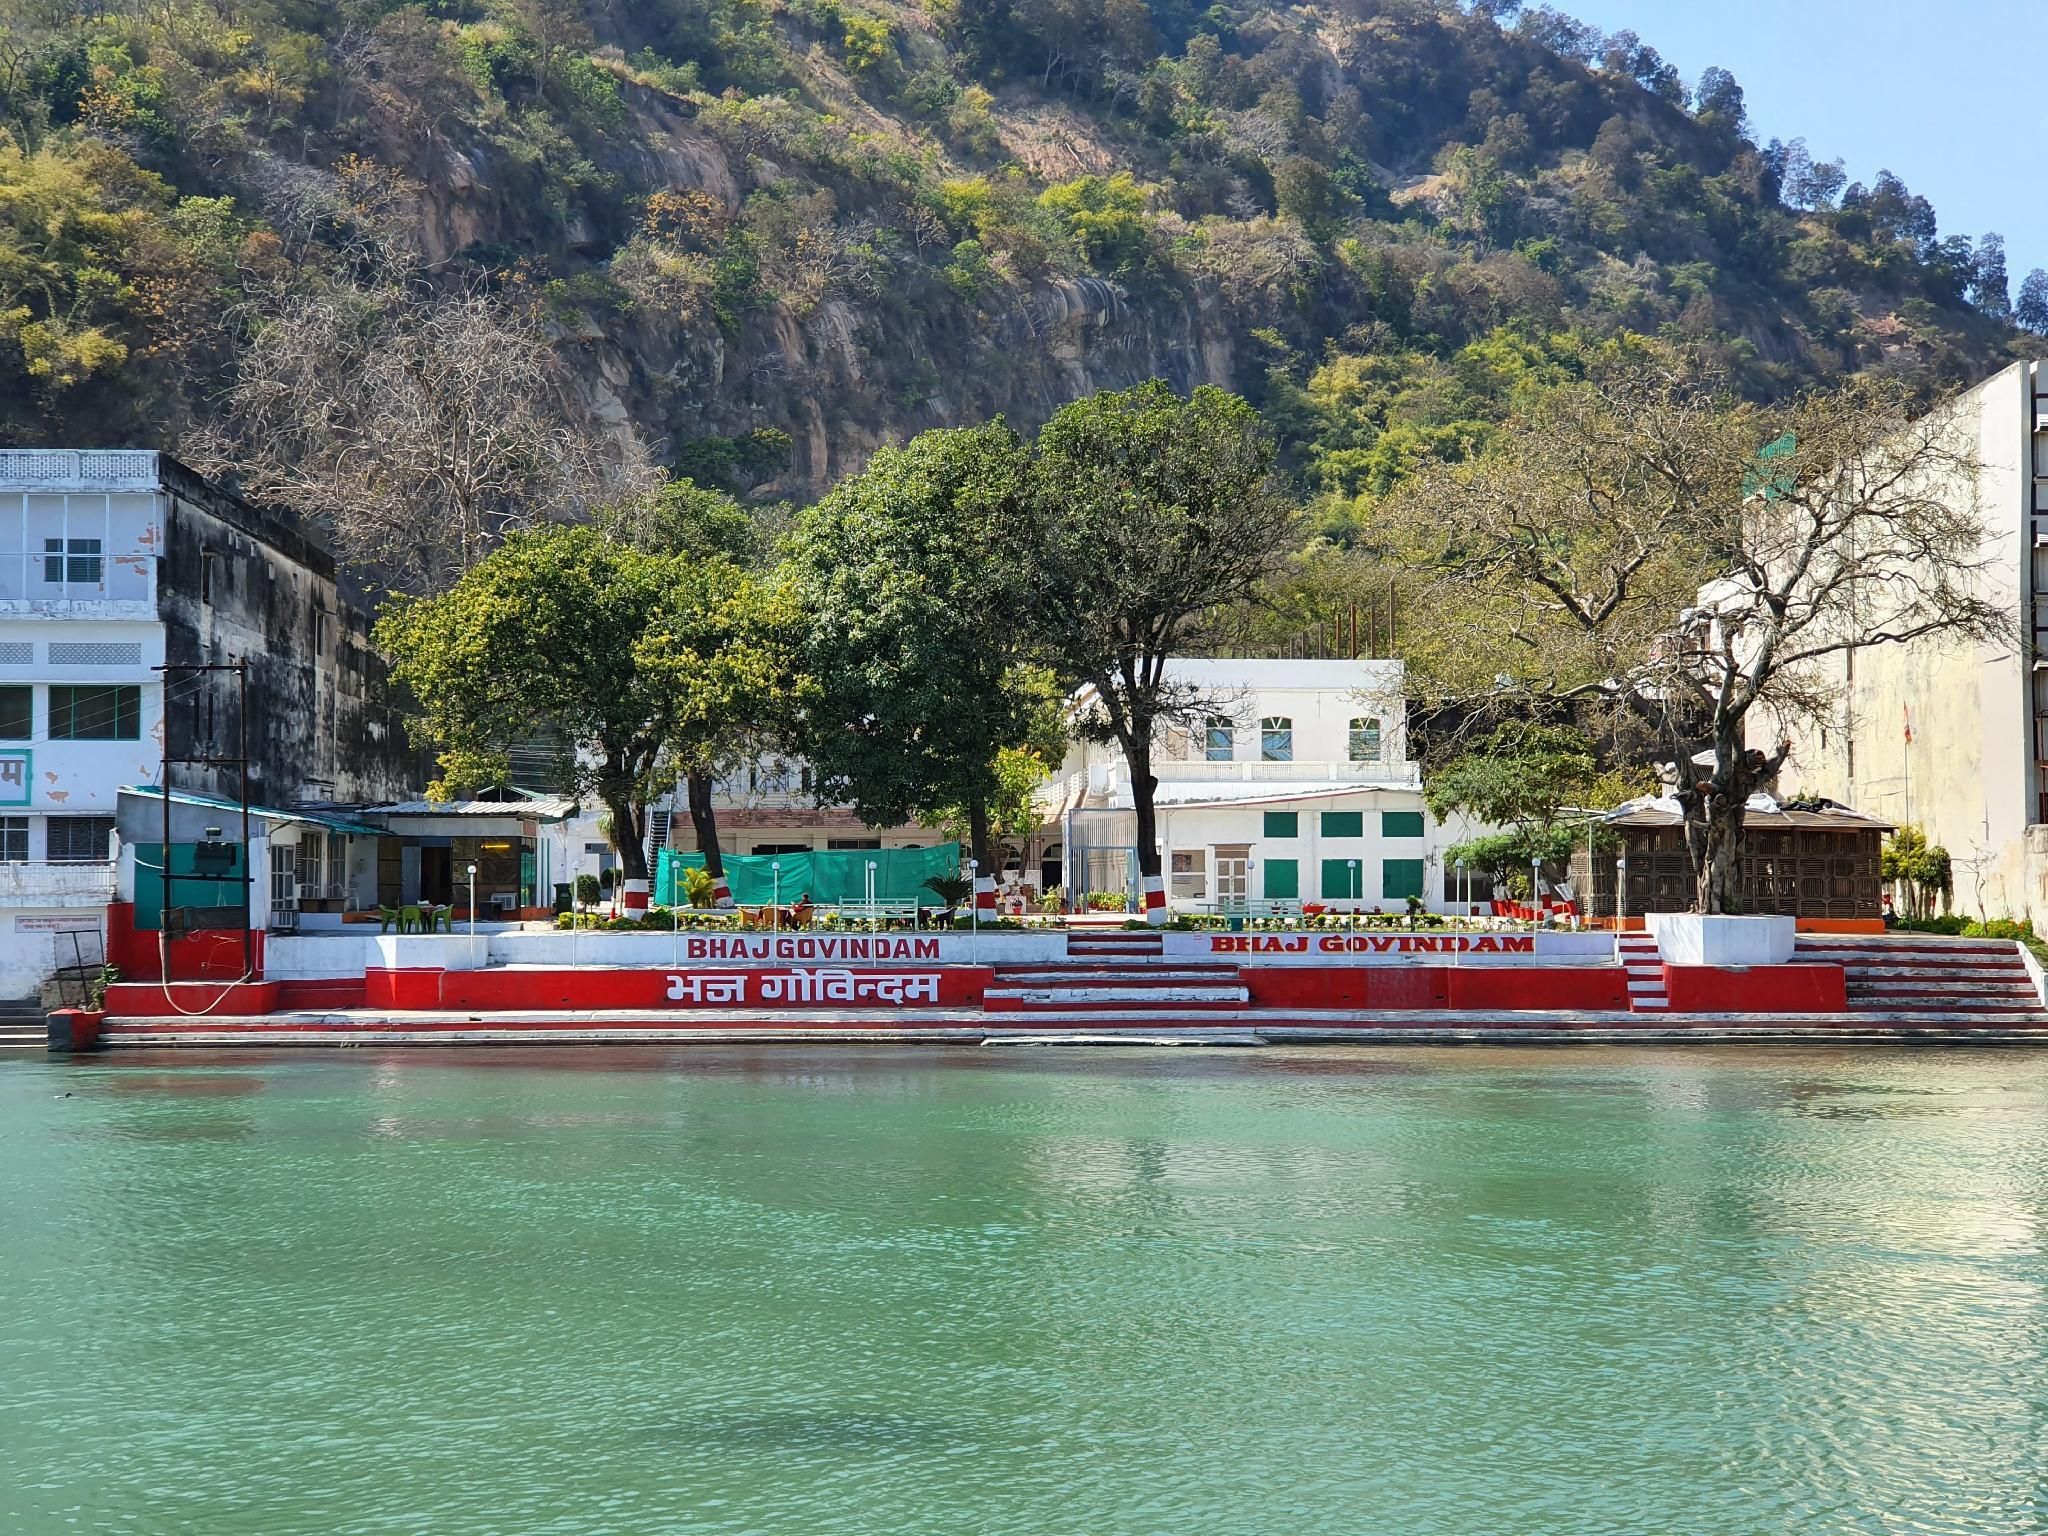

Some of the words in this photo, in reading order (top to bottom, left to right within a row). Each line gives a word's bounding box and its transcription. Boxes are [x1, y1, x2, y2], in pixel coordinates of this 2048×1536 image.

[688, 938, 769, 959] BHAJ
[776, 938, 940, 959] GOVINDAM
[1209, 936, 1308, 953] BHAJ
[1318, 934, 1536, 953] GOVINDAM
[666, 975, 748, 1002] भज
[761, 969, 941, 1004] गोविन्दम
